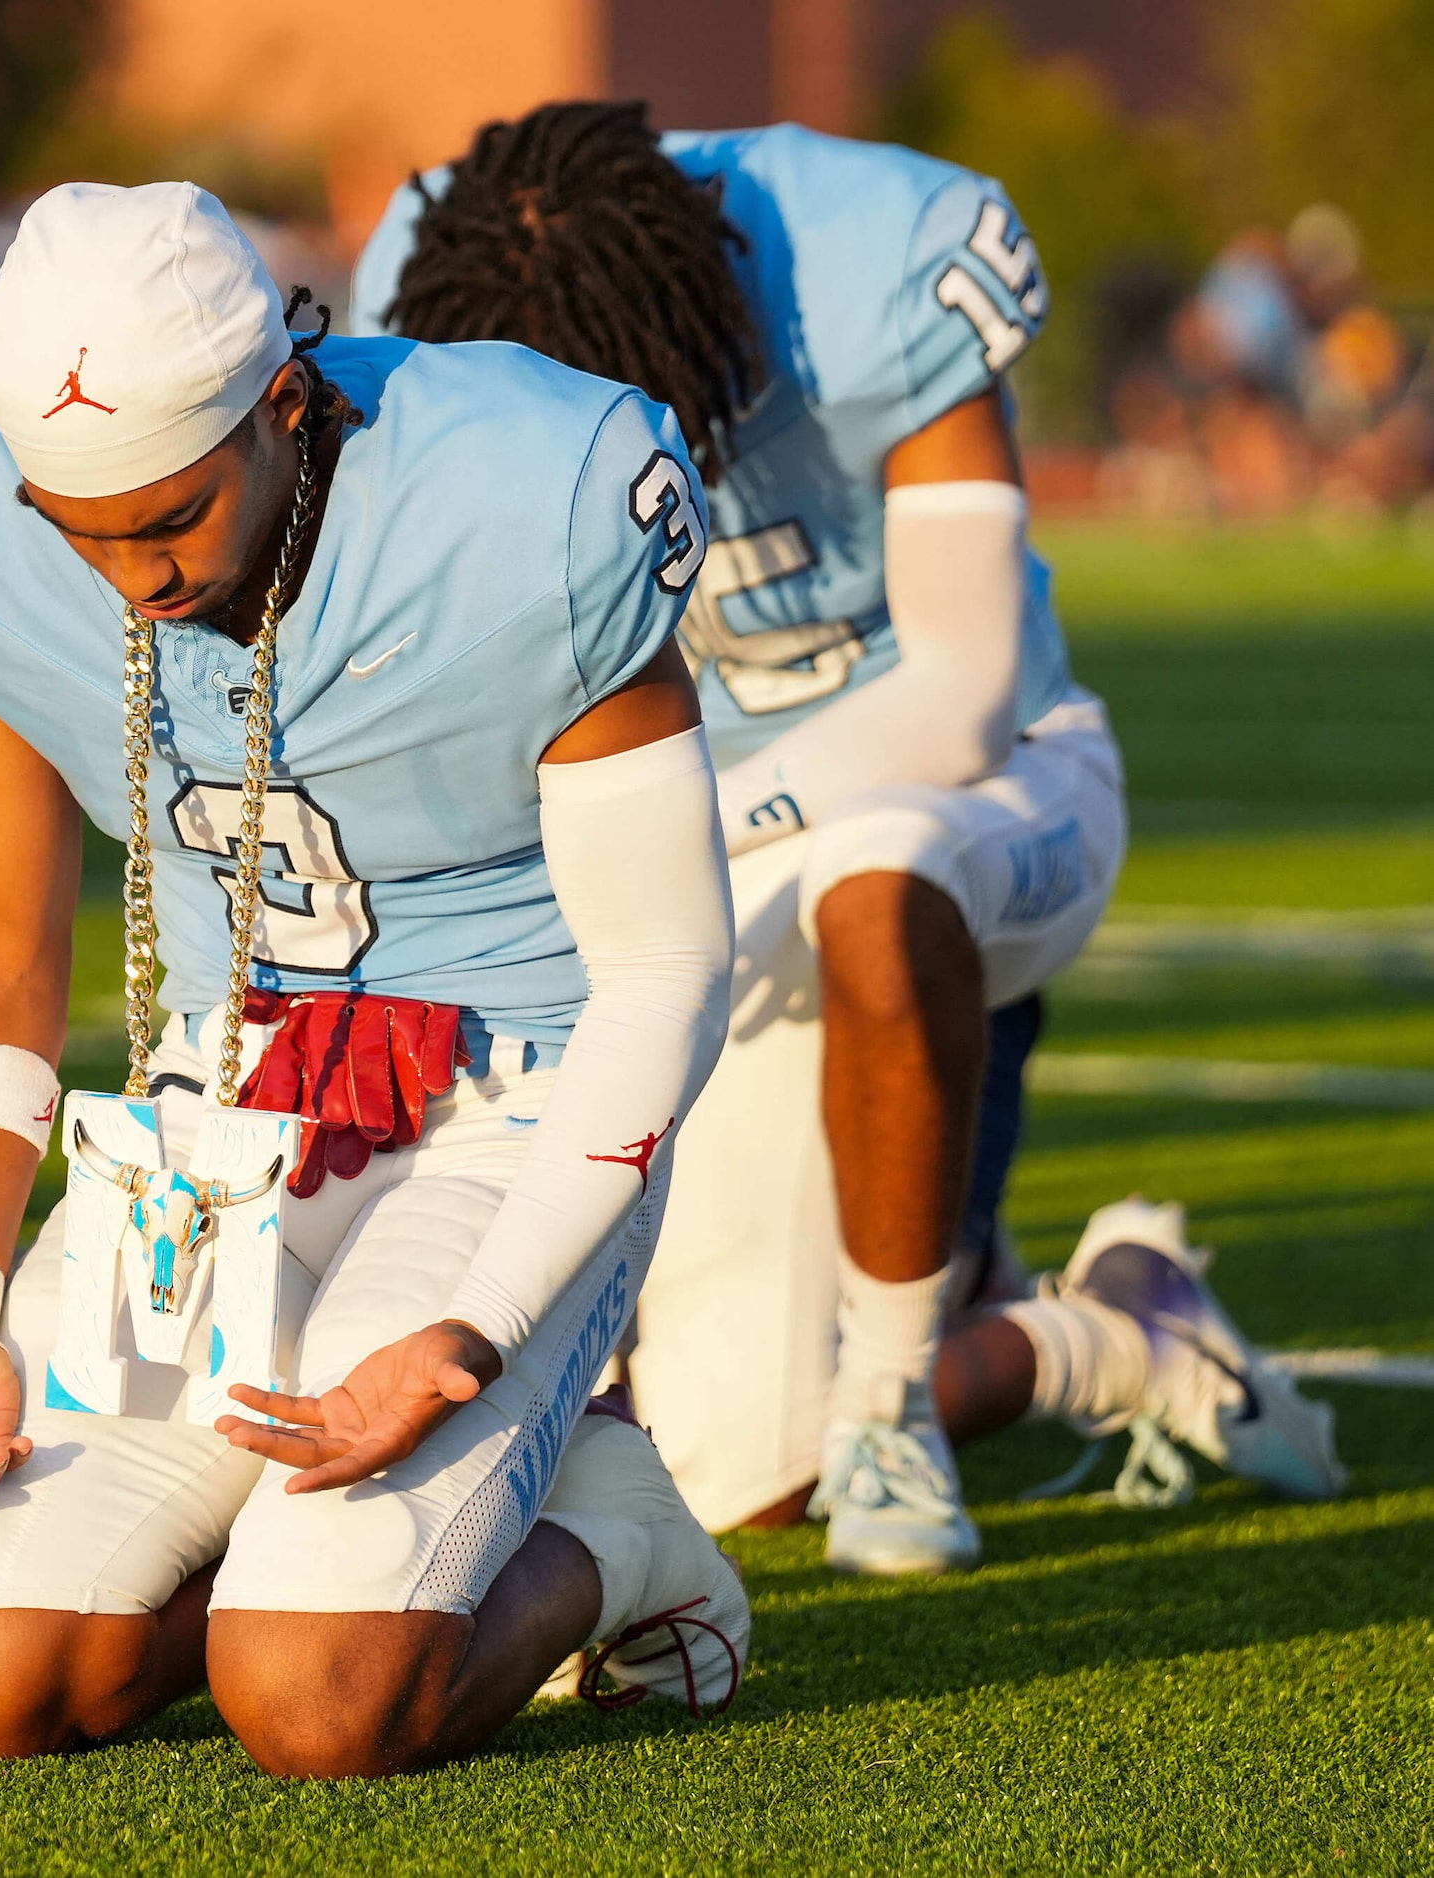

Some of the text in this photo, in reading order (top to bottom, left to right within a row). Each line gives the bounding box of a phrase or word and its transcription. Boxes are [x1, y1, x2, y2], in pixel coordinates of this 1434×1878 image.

[935, 199, 1050, 375] 15
[628, 449, 708, 596] 3
[166, 778, 380, 977] 3
